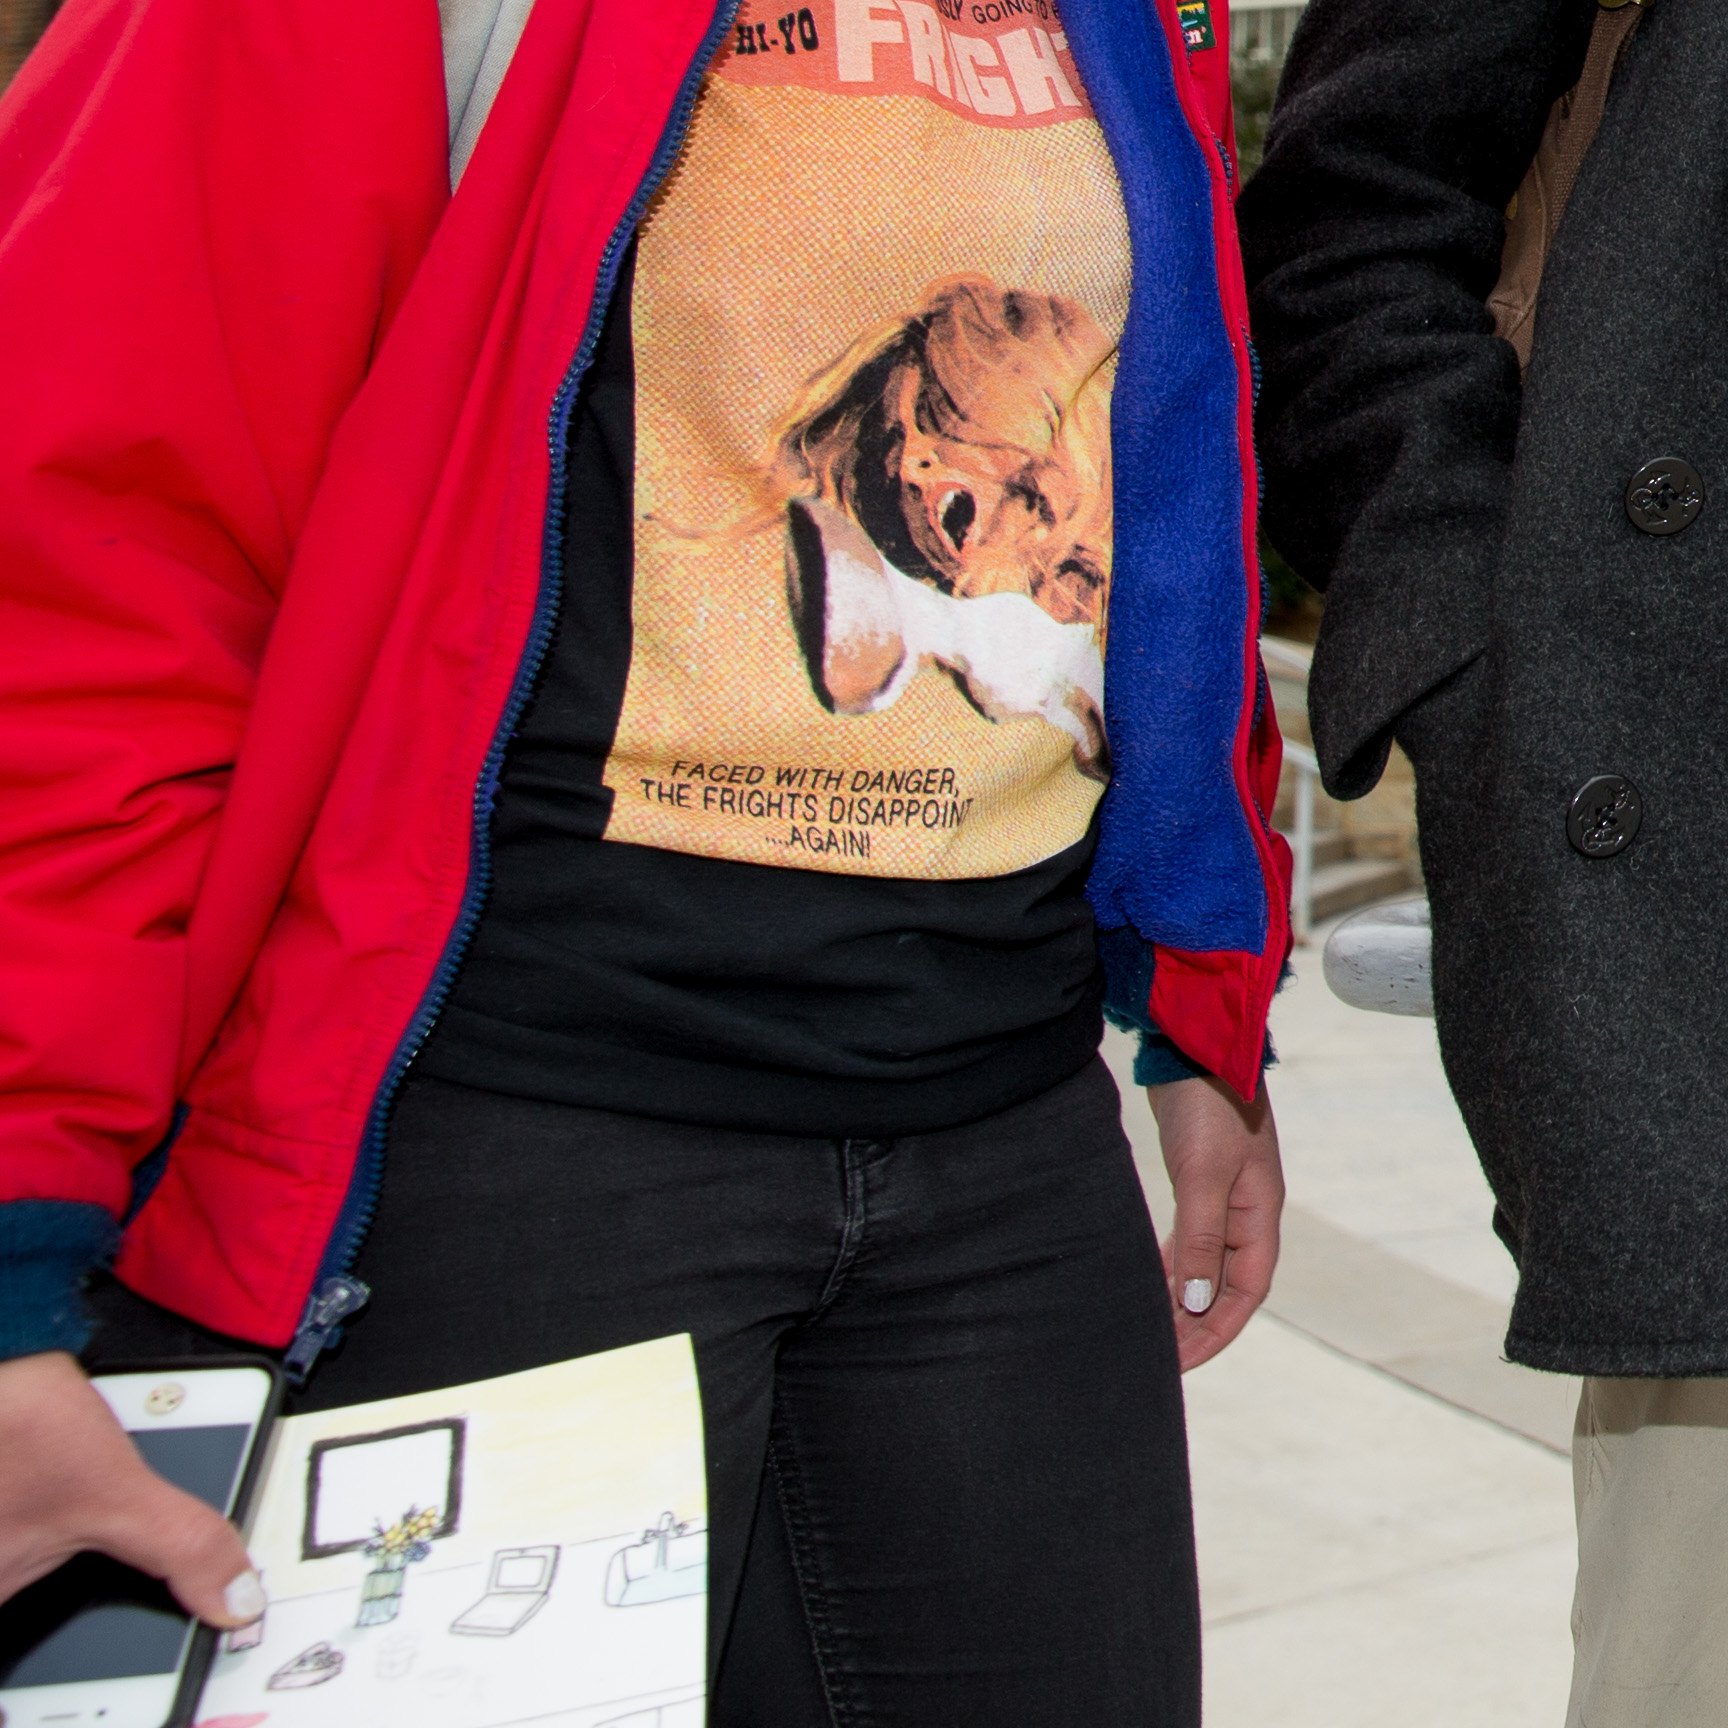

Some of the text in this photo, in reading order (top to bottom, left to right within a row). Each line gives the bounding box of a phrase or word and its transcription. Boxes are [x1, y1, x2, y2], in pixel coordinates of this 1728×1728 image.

[736, 7, 820, 56] HI-YO
[640, 778, 974, 829] THE FRIGHTS DISAPPOINT
[671, 760, 960, 798] FACED WITH DANGER,
